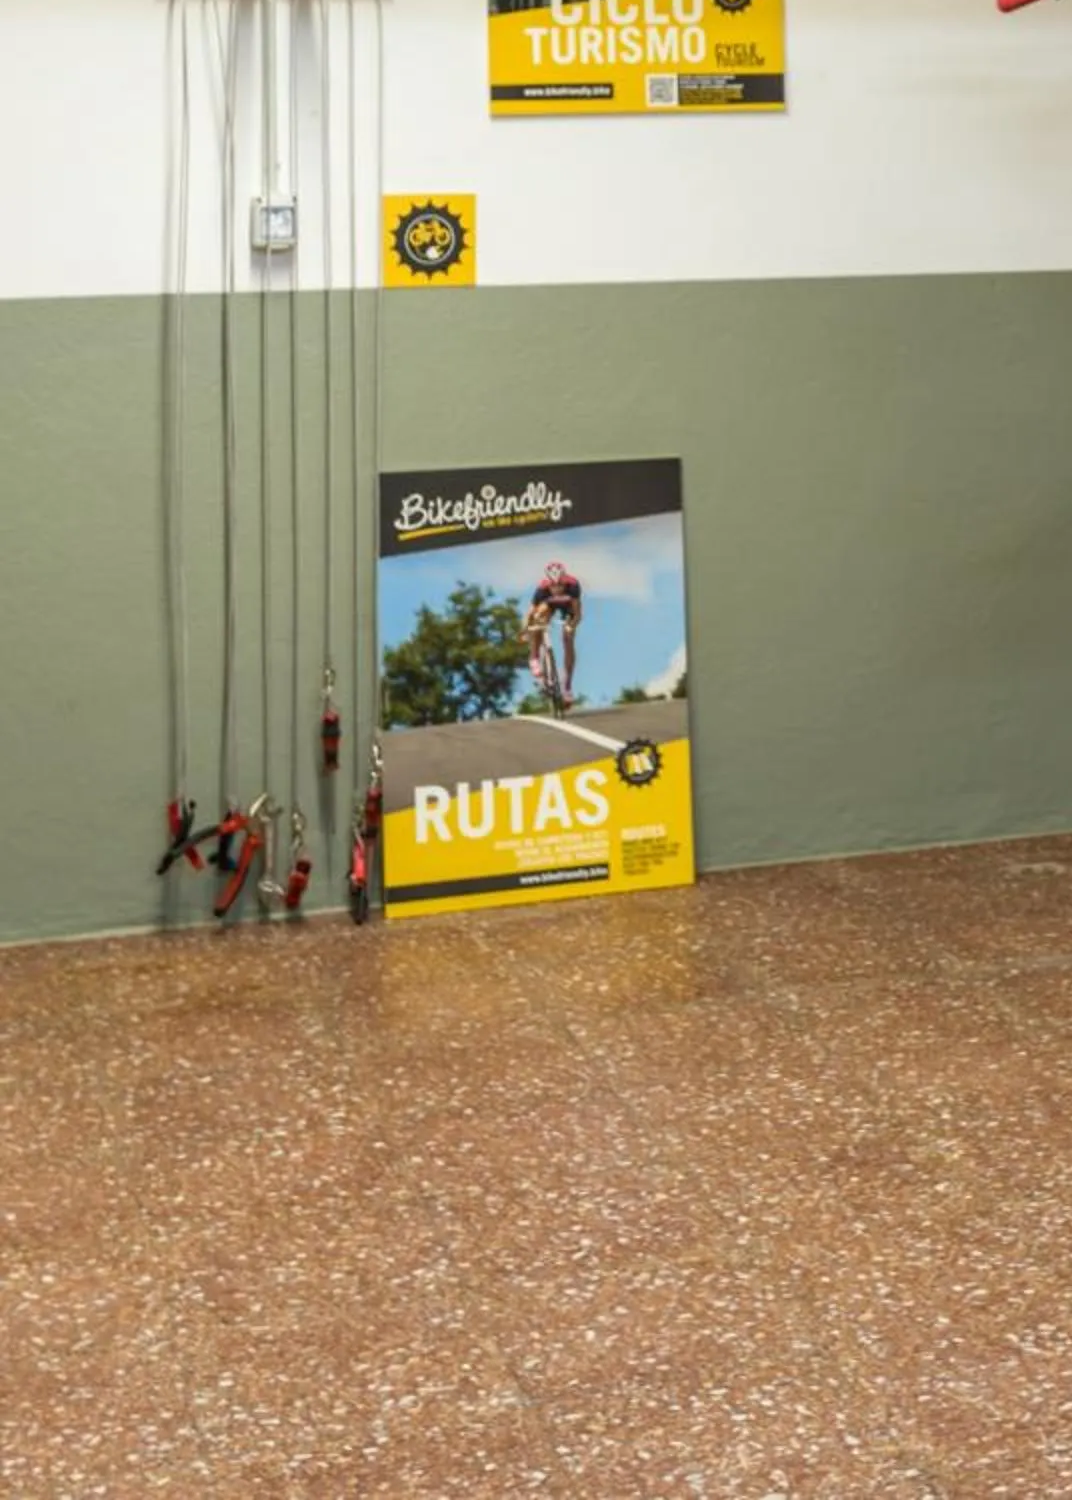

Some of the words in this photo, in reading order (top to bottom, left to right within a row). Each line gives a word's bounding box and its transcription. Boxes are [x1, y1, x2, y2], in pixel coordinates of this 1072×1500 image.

[523, 26, 706, 66] TURISMO
[393, 481, 573, 531] Bikefriendly
[414, 768, 610, 844] RUTAS
